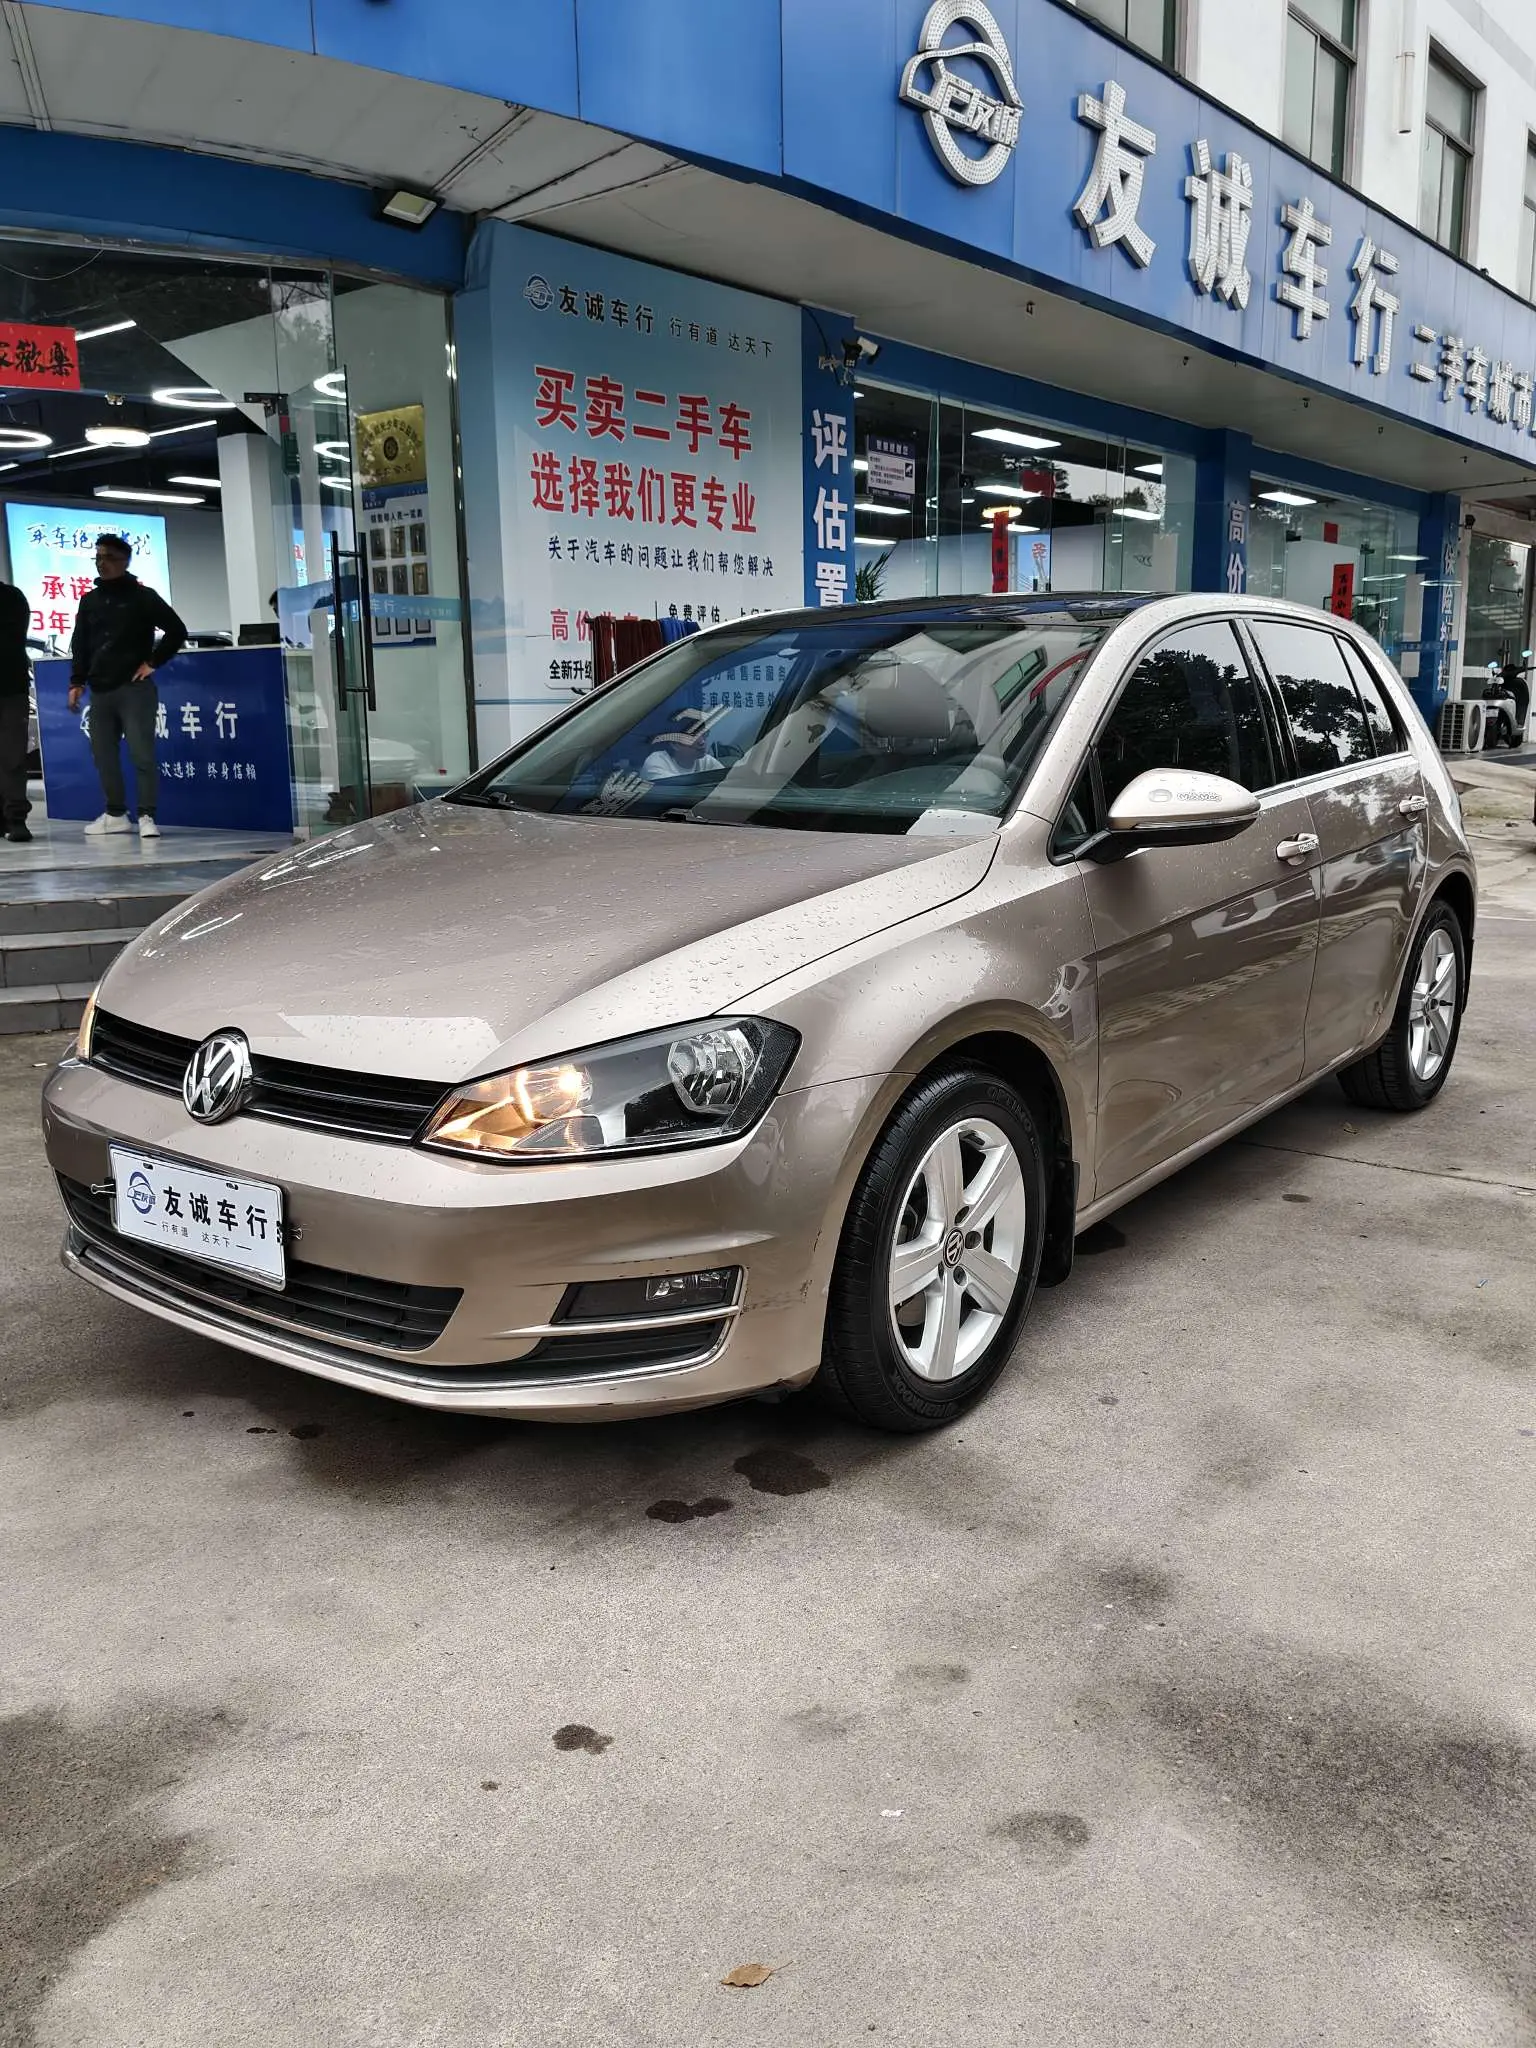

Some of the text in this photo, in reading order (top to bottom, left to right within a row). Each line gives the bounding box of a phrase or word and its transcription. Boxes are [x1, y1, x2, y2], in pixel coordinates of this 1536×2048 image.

[1073, 79, 1399, 375] 友诚车行
[557, 285, 774, 358] 友诚车行 行有道 达天下
[534, 364, 752, 461] 买卖二手车
[530, 451, 757, 533] 选择我们更专业
[548, 535, 774, 577] 关于汽车的问题让我们帮您解决
[1227, 501, 1246, 593] 高价
[207, 763, 257, 780] 终身信赖
[161, 1220, 232, 1248] 行有道 达天下
[162, 1186, 268, 1240] 友诚车行
